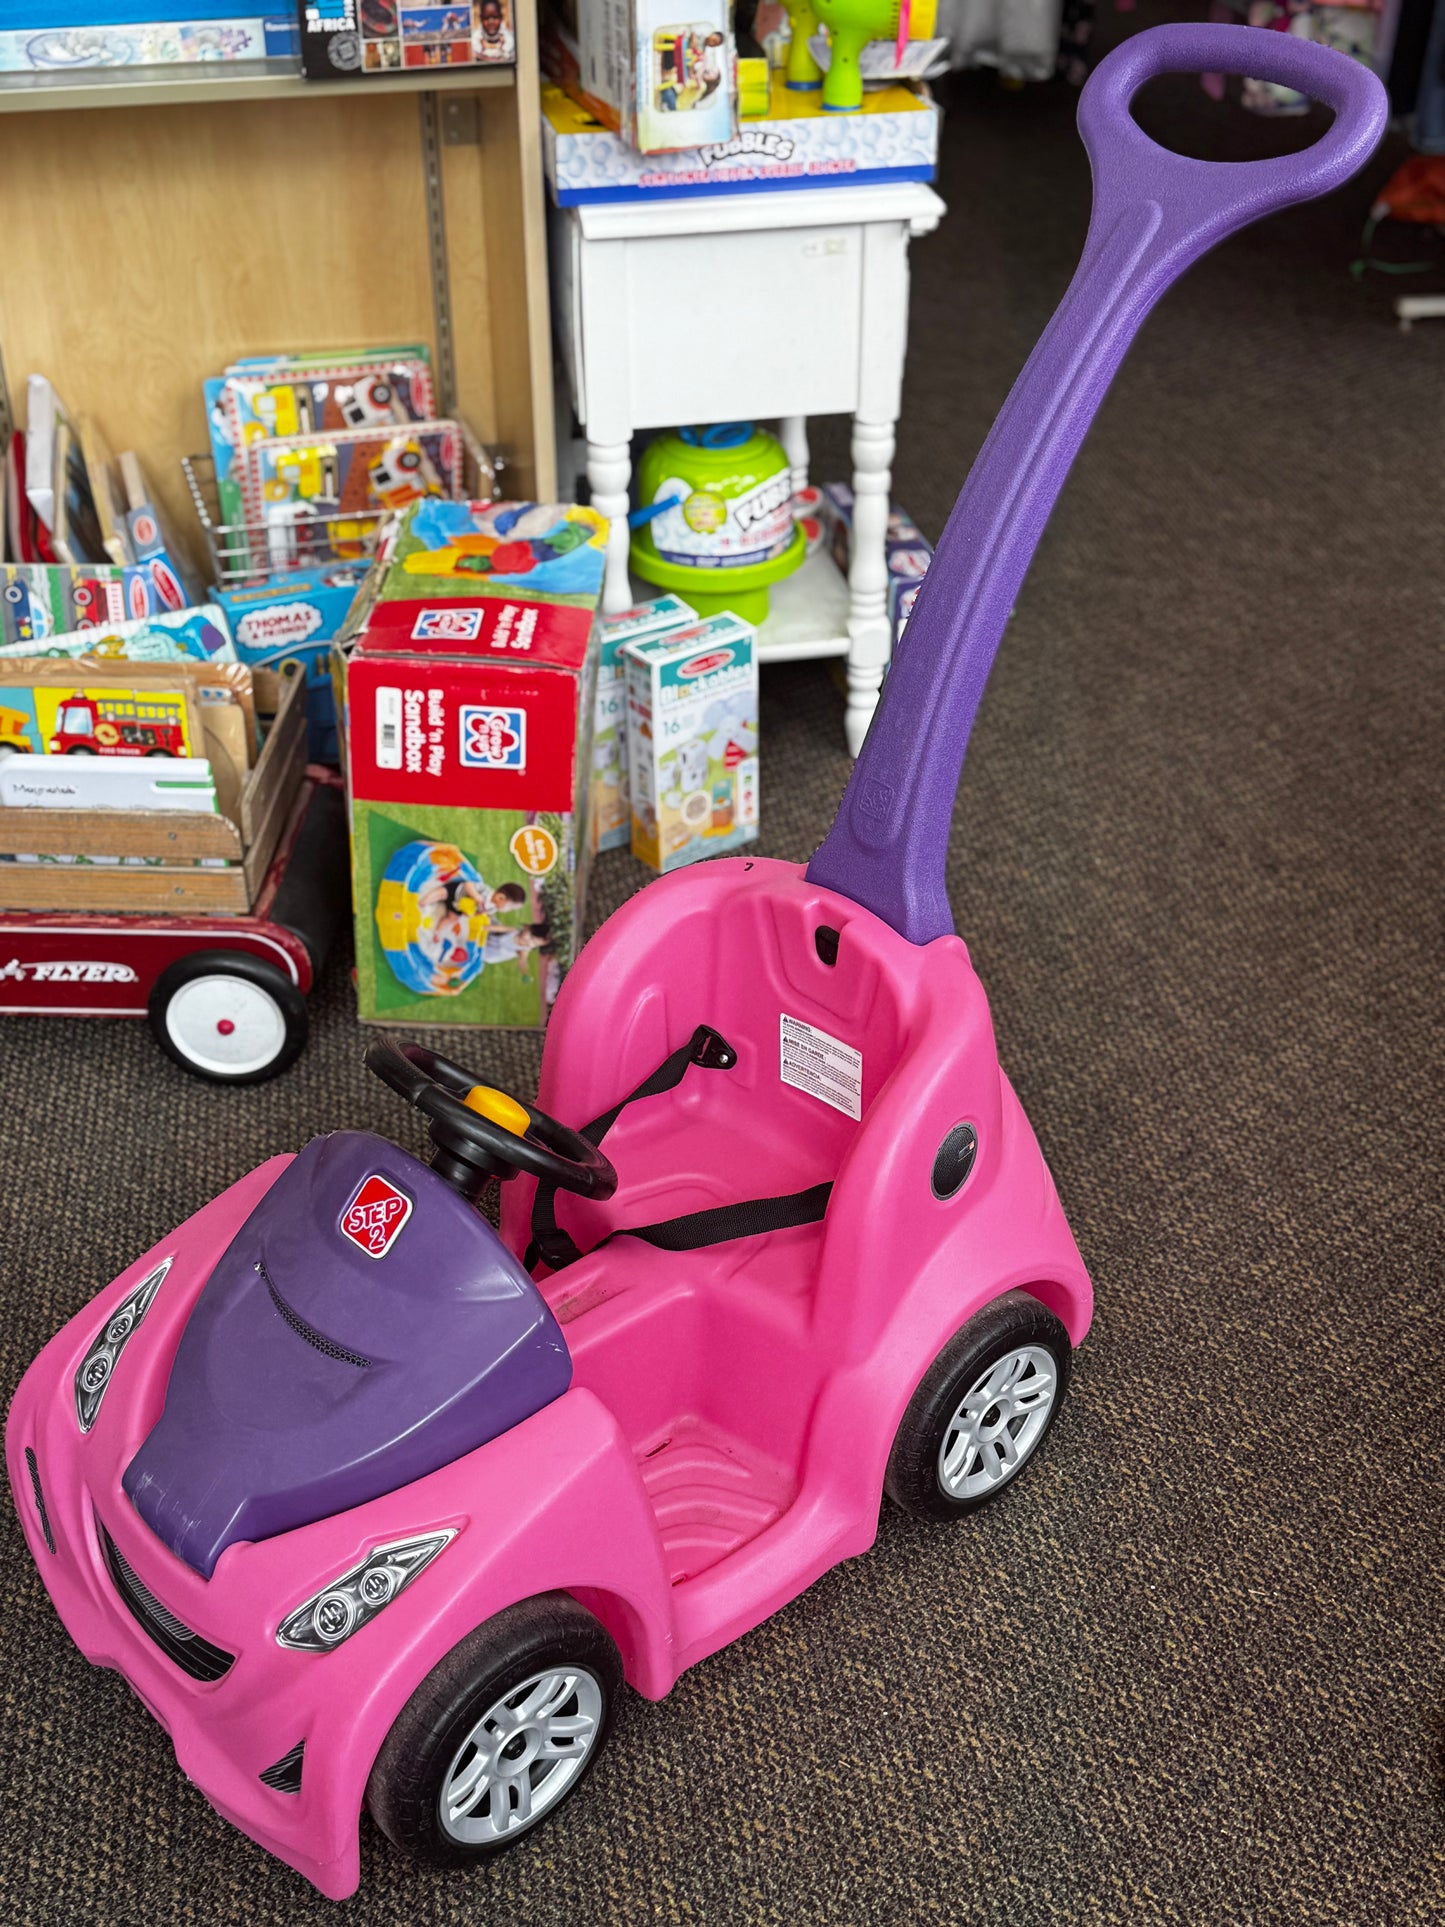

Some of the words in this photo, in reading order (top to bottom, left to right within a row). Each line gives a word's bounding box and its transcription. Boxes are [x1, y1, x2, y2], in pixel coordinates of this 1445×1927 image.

[306, 17, 356, 33] AFRICA
[698, 131, 796, 168] FUBBLES
[246, 611, 312, 631] THOMAS
[428, 689, 445, 727] Build
[404, 689, 427, 774] Sandbox
[490, 717, 505, 759] Grow
[663, 718, 681, 736] 16
[425, 745, 446, 777] Play
[31, 961, 136, 983] FLYER
[348, 1196, 403, 1233] STEP
[368, 1222, 386, 1250] 2
